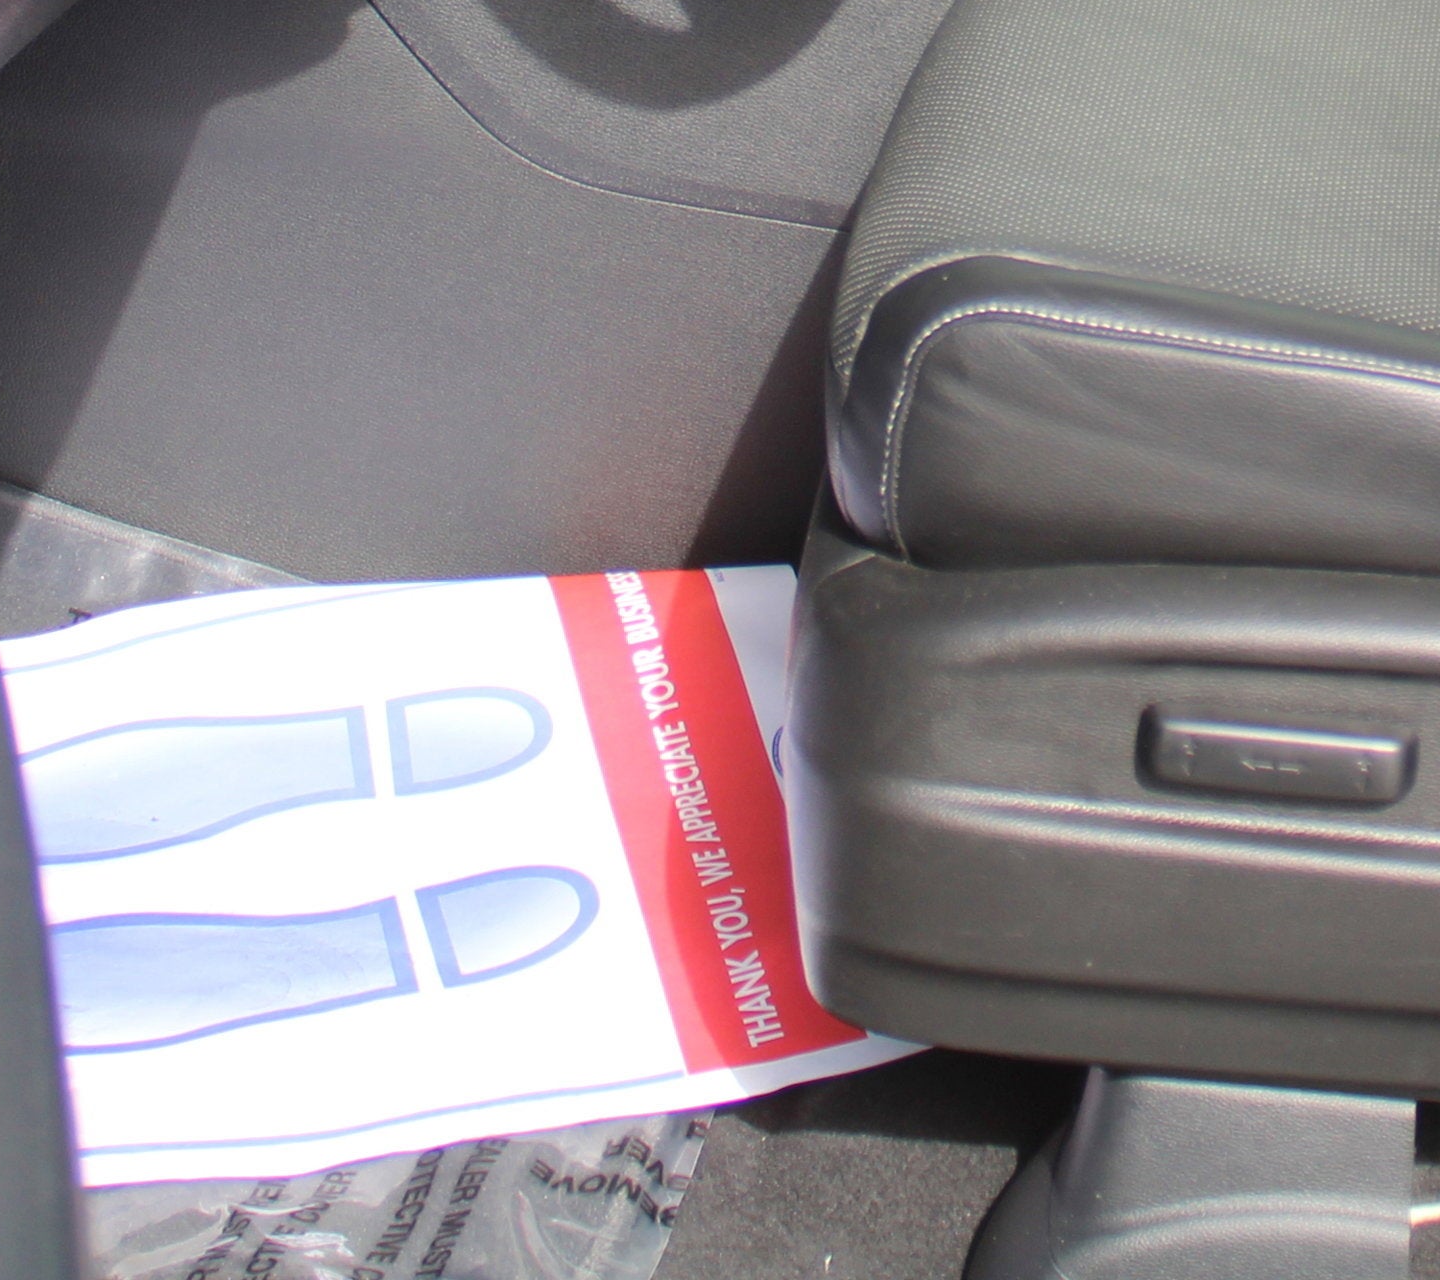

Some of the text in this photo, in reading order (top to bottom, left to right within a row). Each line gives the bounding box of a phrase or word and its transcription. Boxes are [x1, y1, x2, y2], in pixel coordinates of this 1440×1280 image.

[631, 645, 680, 721] YOUR
[652, 721, 722, 843] APPRECIATE
[691, 847, 735, 888] WE
[705, 887, 754, 951] YOU,
[723, 948, 785, 1049] THANK
